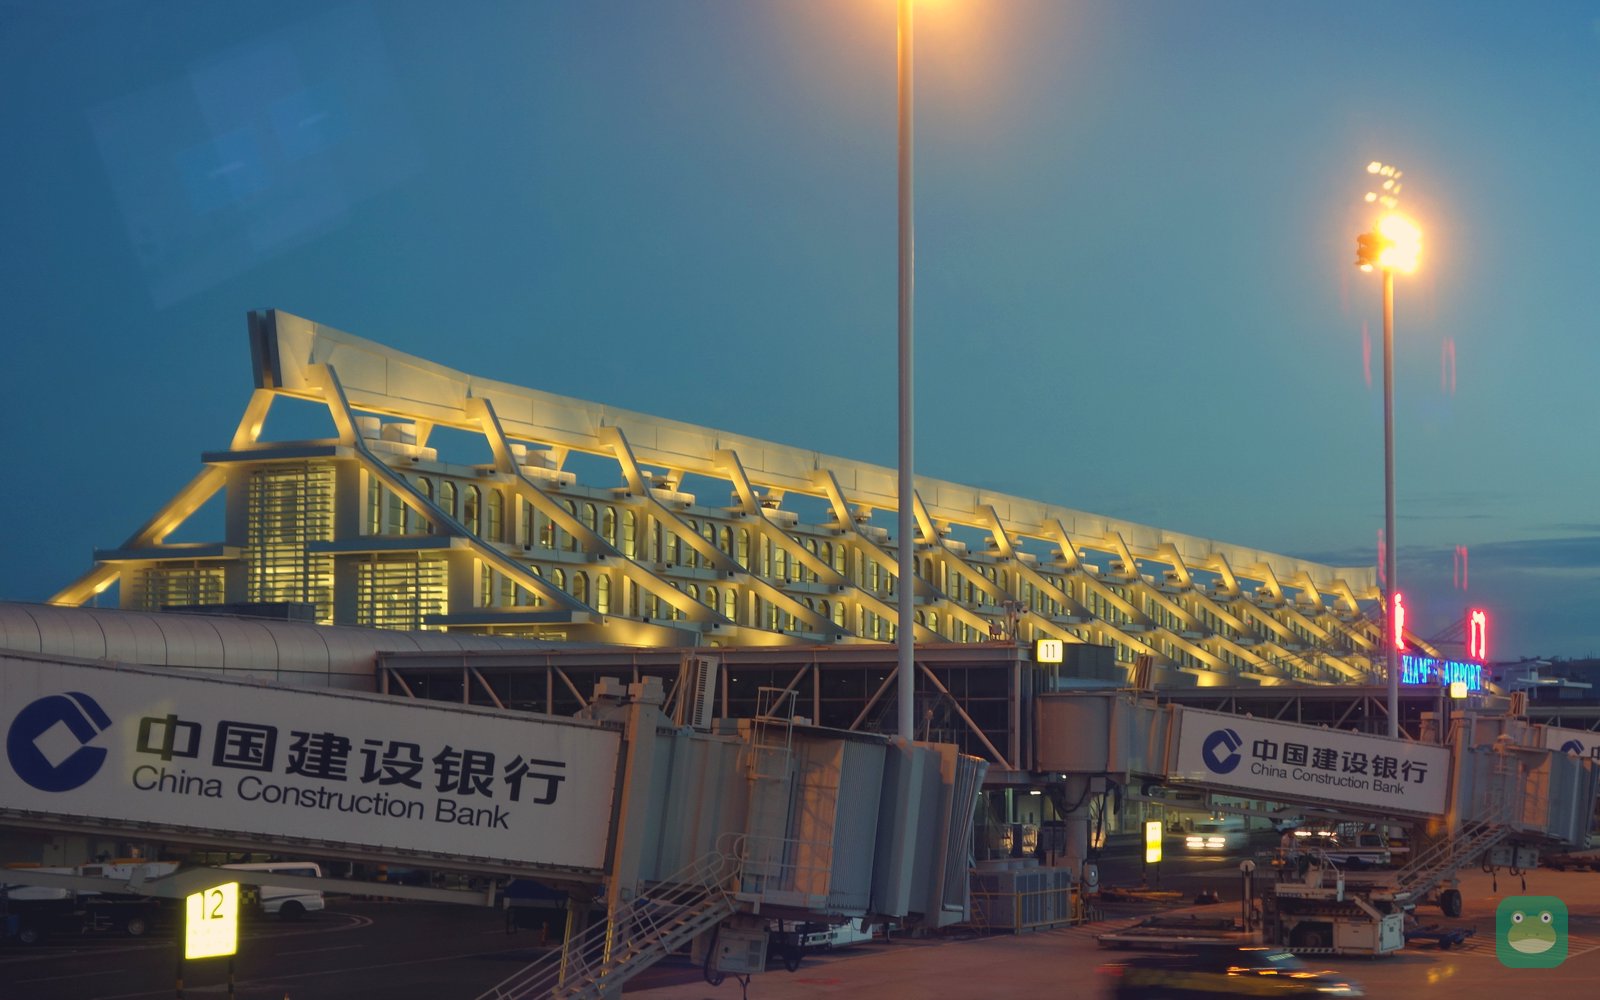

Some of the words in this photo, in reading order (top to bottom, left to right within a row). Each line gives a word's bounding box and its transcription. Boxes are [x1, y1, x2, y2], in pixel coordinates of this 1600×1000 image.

[1045, 644, 1055, 658] 11
[1443, 661, 1482, 690] AIRPORT
[136, 714, 566, 805] 中国建设银行
[1252, 739, 1428, 784] 中国建设银行
[1251, 762, 1287, 779] China
[1292, 768, 1369, 791] Construction
[1373, 779, 1404, 795] Bank
[132, 765, 222, 799] China
[237, 776, 424, 820] Construction
[435, 798, 510, 829] Bank
[200, 889, 224, 920] 12
